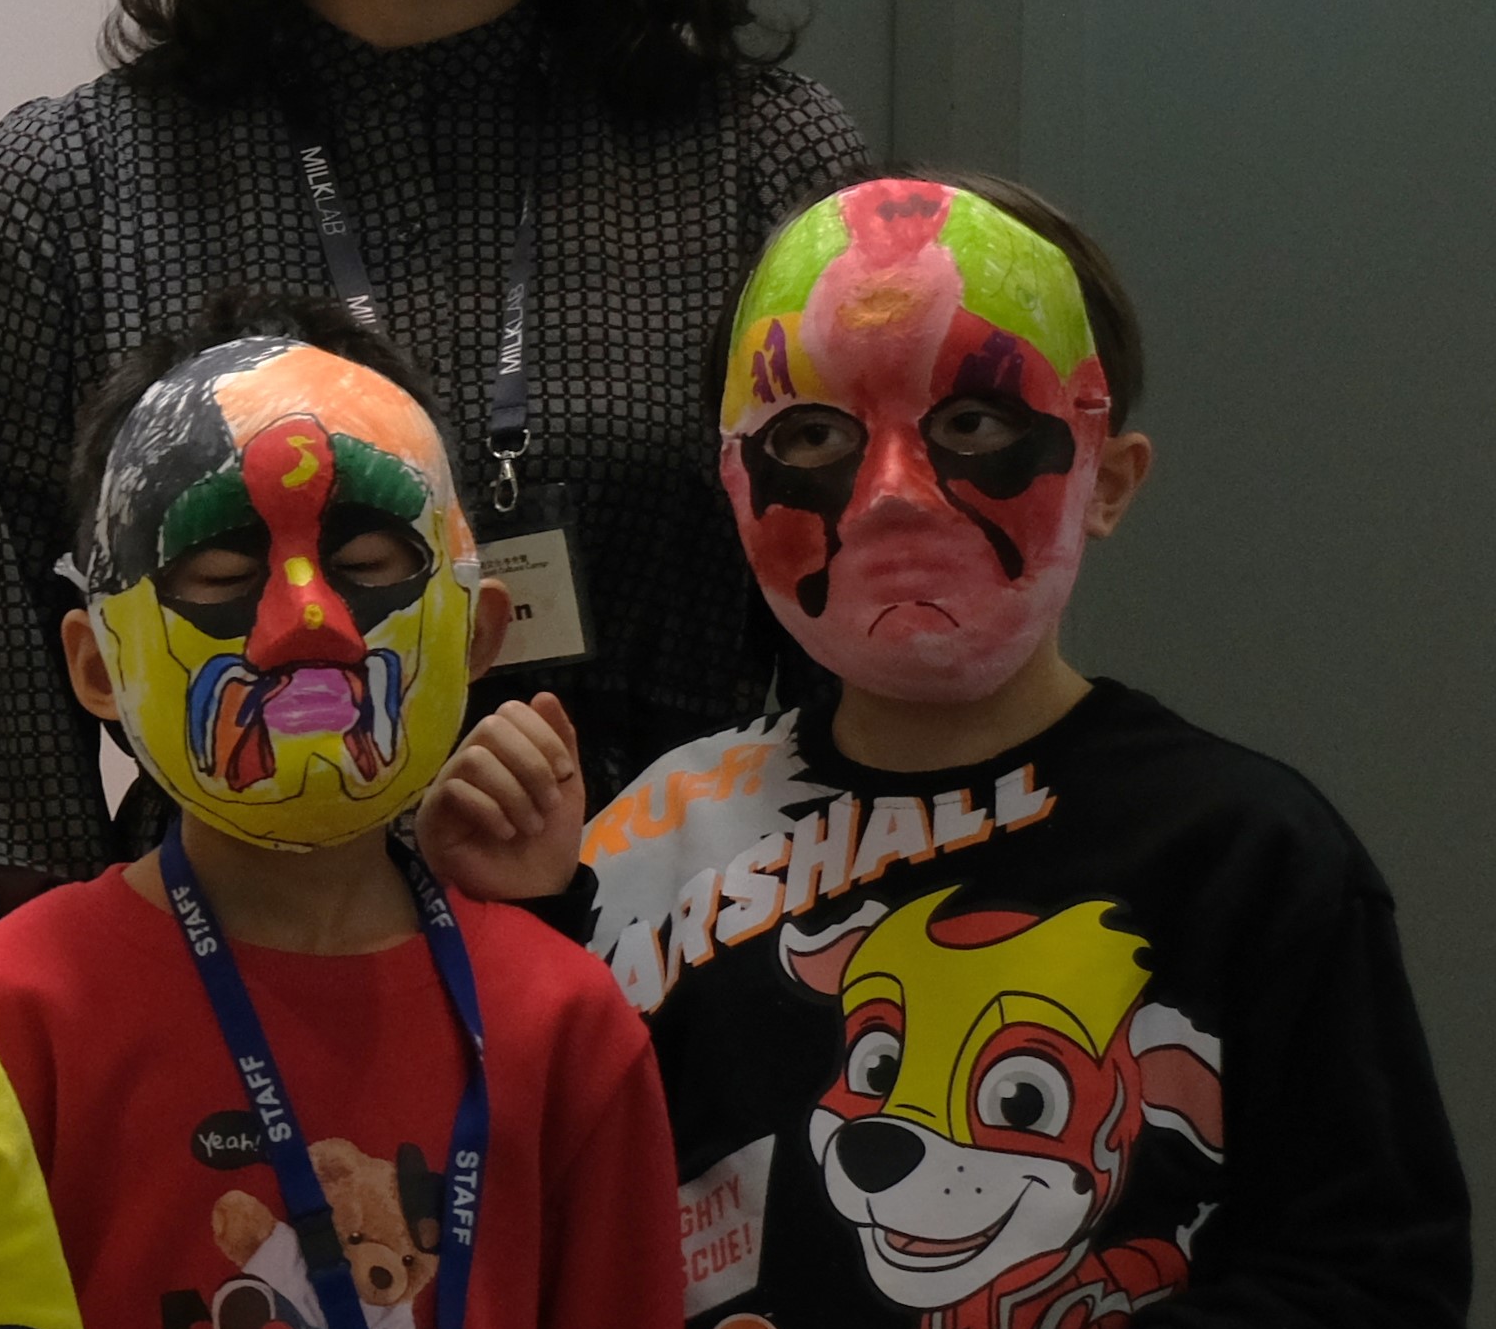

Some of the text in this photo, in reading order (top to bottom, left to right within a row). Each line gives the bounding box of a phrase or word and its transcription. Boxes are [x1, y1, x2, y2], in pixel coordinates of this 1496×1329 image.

[300, 145, 347, 236] MILKLAB
[172, 884, 218, 957] STAFF
[409, 860, 455, 929] STAFF
[611, 761, 1058, 1015] ARSHALL
[239, 1055, 292, 1143] STAFF
[198, 1130, 262, 1158] Yeah!
[451, 1149, 480, 1247] STAFF
[680, 1175, 741, 1239] GHTY
